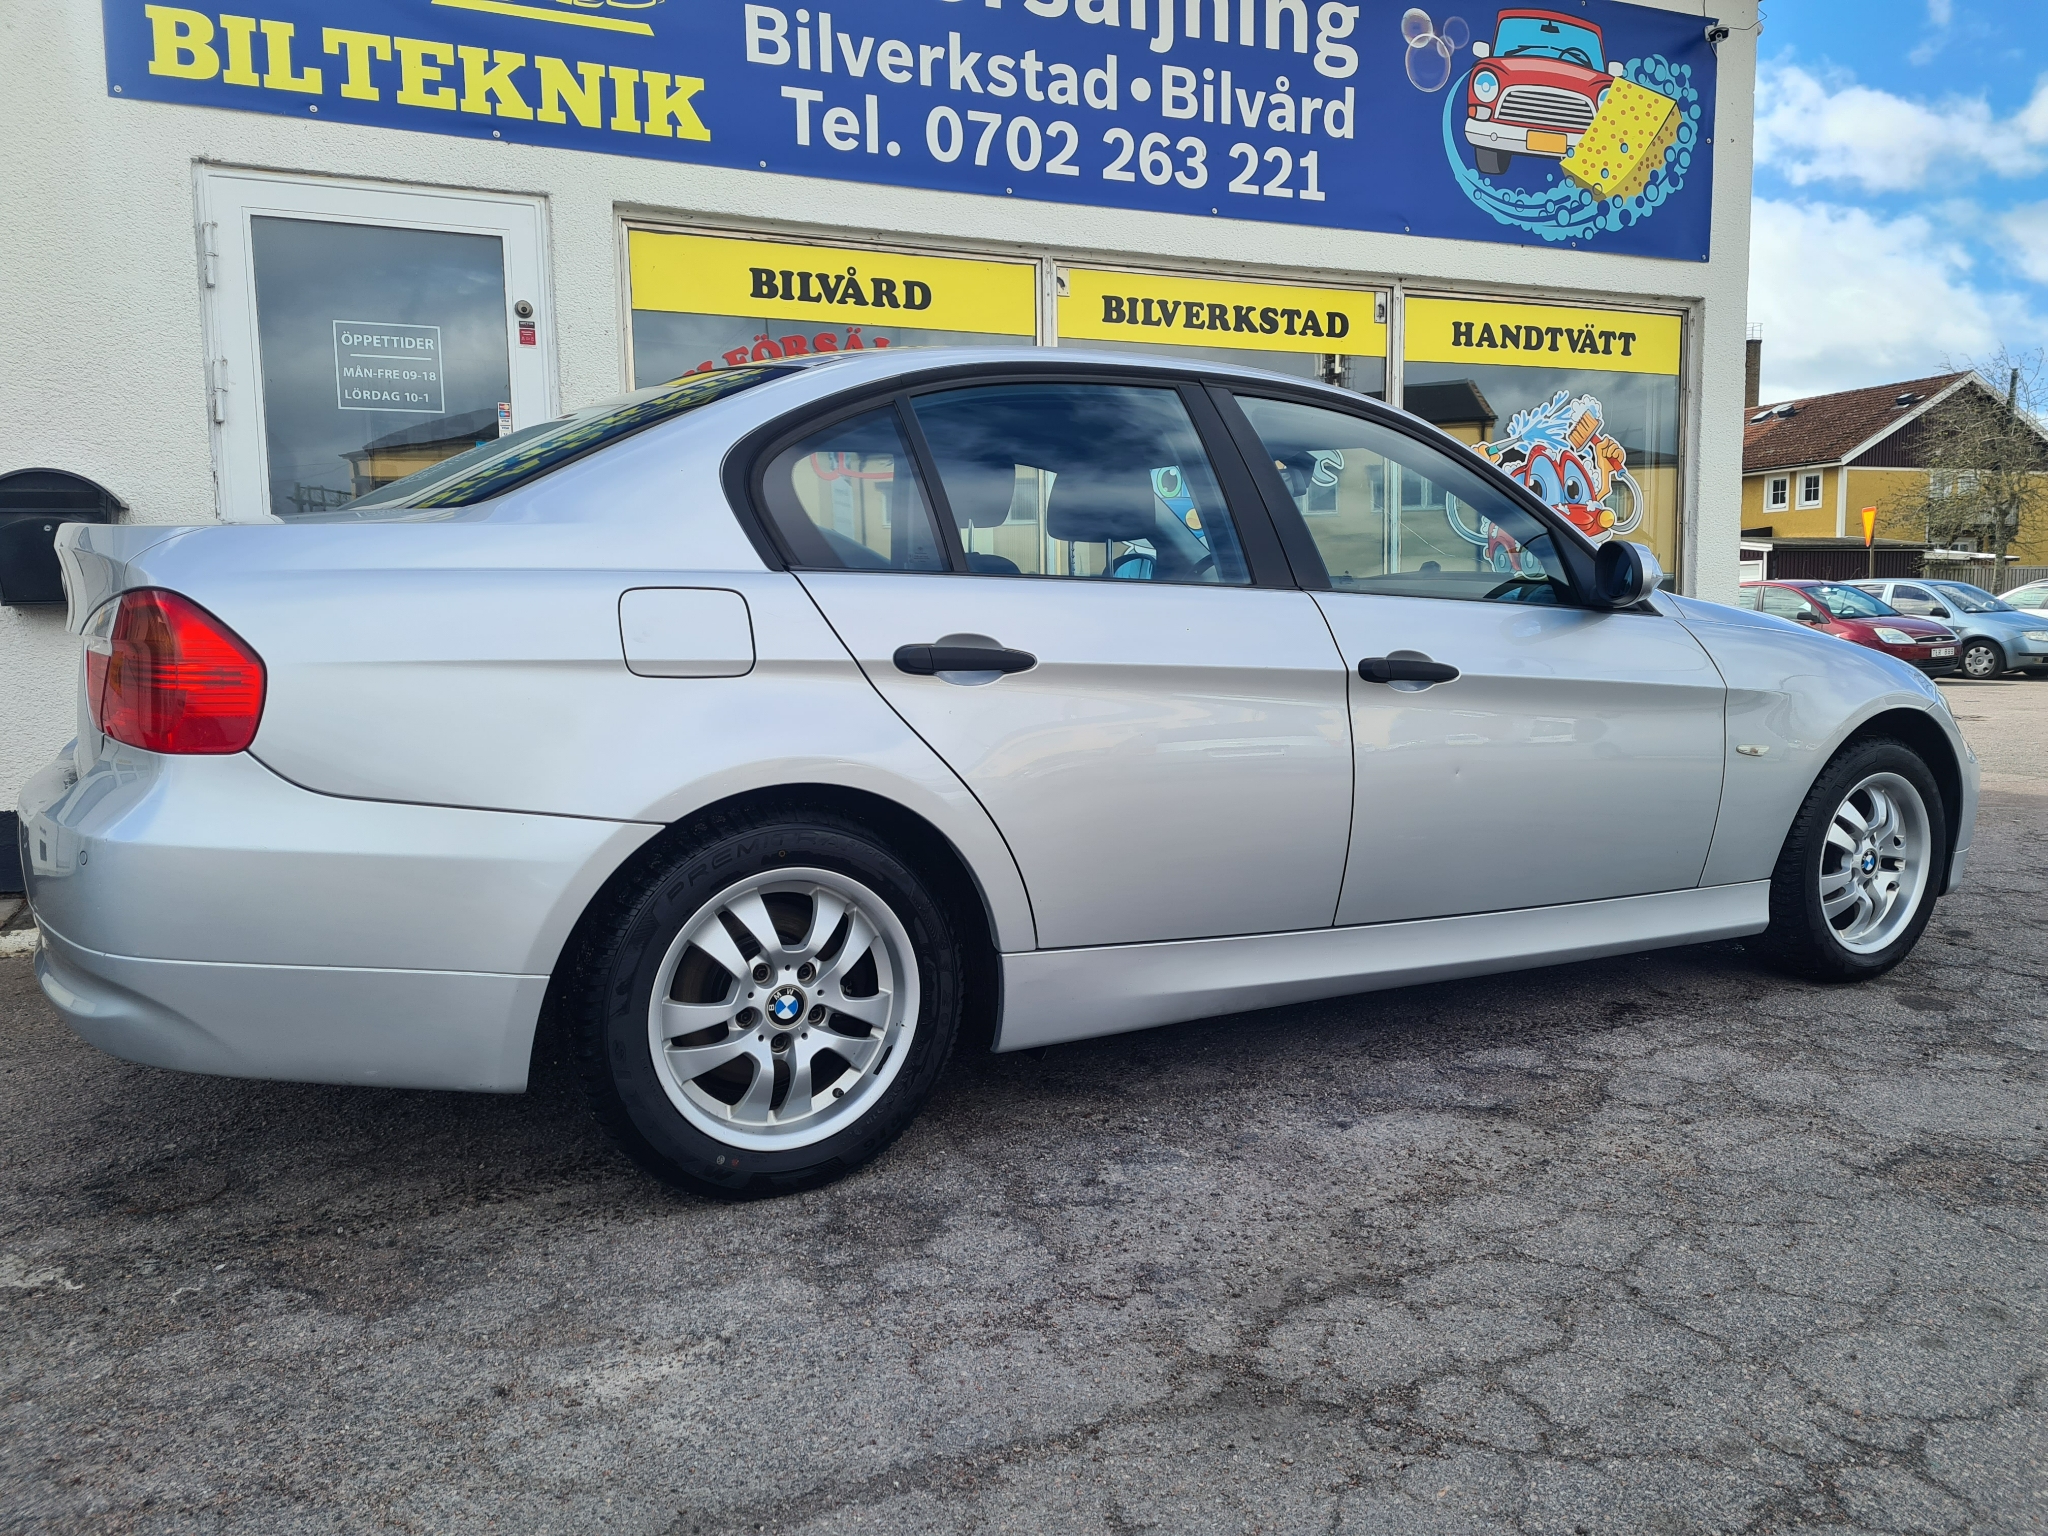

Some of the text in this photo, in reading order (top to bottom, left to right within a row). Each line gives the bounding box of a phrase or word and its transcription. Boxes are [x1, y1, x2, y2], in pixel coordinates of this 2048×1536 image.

[144, 3, 711, 142] BILTEKNIK
[744, 3, 1355, 140] Bilverkstad Bilvård
[780, 85, 1326, 202] Tel. 0702 263 221
[748, 266, 932, 311] BILVÅRD
[1101, 295, 1350, 339] BILVERKSTAD
[340, 330, 435, 350] ÖPPETTIDER
[1451, 320, 1637, 357] HANDTVÄTT
[343, 364, 437, 381] MÅN-FRE 09-18
[344, 387, 429, 403] LÖRDAG 10-1
[768, 988, 794, 1012] BMW
